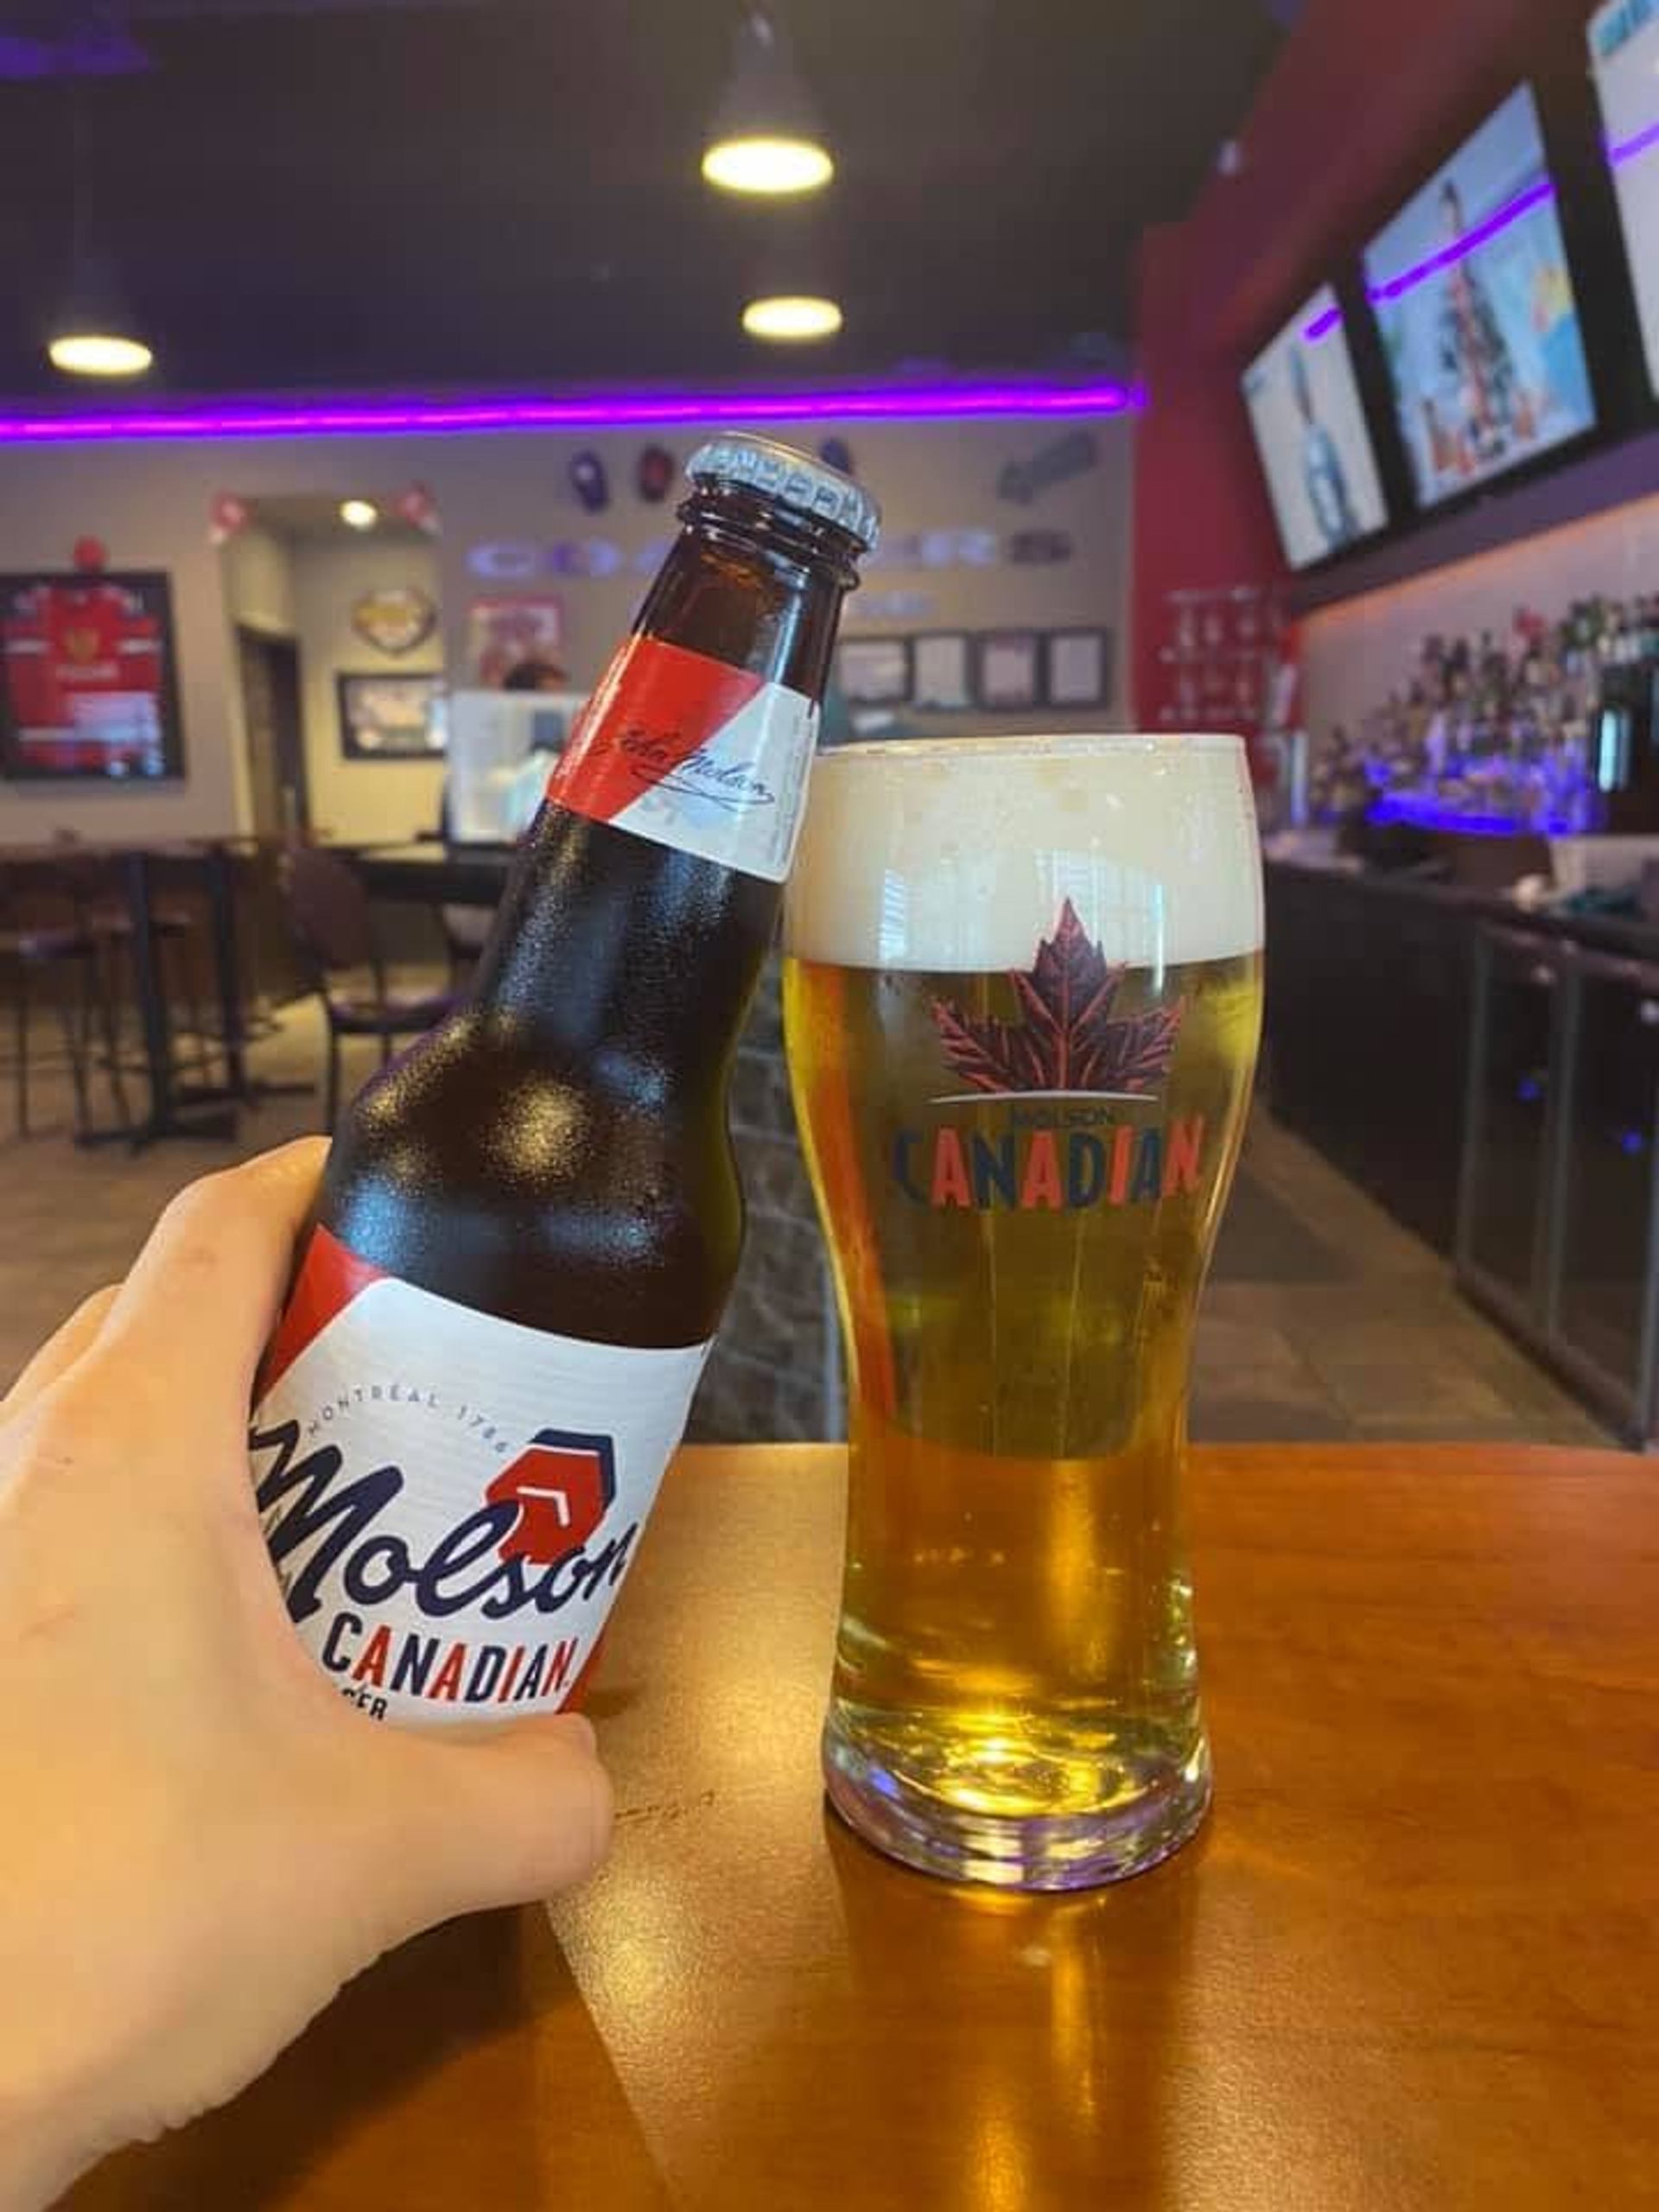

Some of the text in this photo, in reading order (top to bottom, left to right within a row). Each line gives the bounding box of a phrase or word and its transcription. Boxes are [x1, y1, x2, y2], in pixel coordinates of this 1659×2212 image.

[893, 1115, 1205, 1210] CANADIAN
[248, 1419, 639, 1624] Molson
[322, 1611, 578, 1703] CANADIAN
